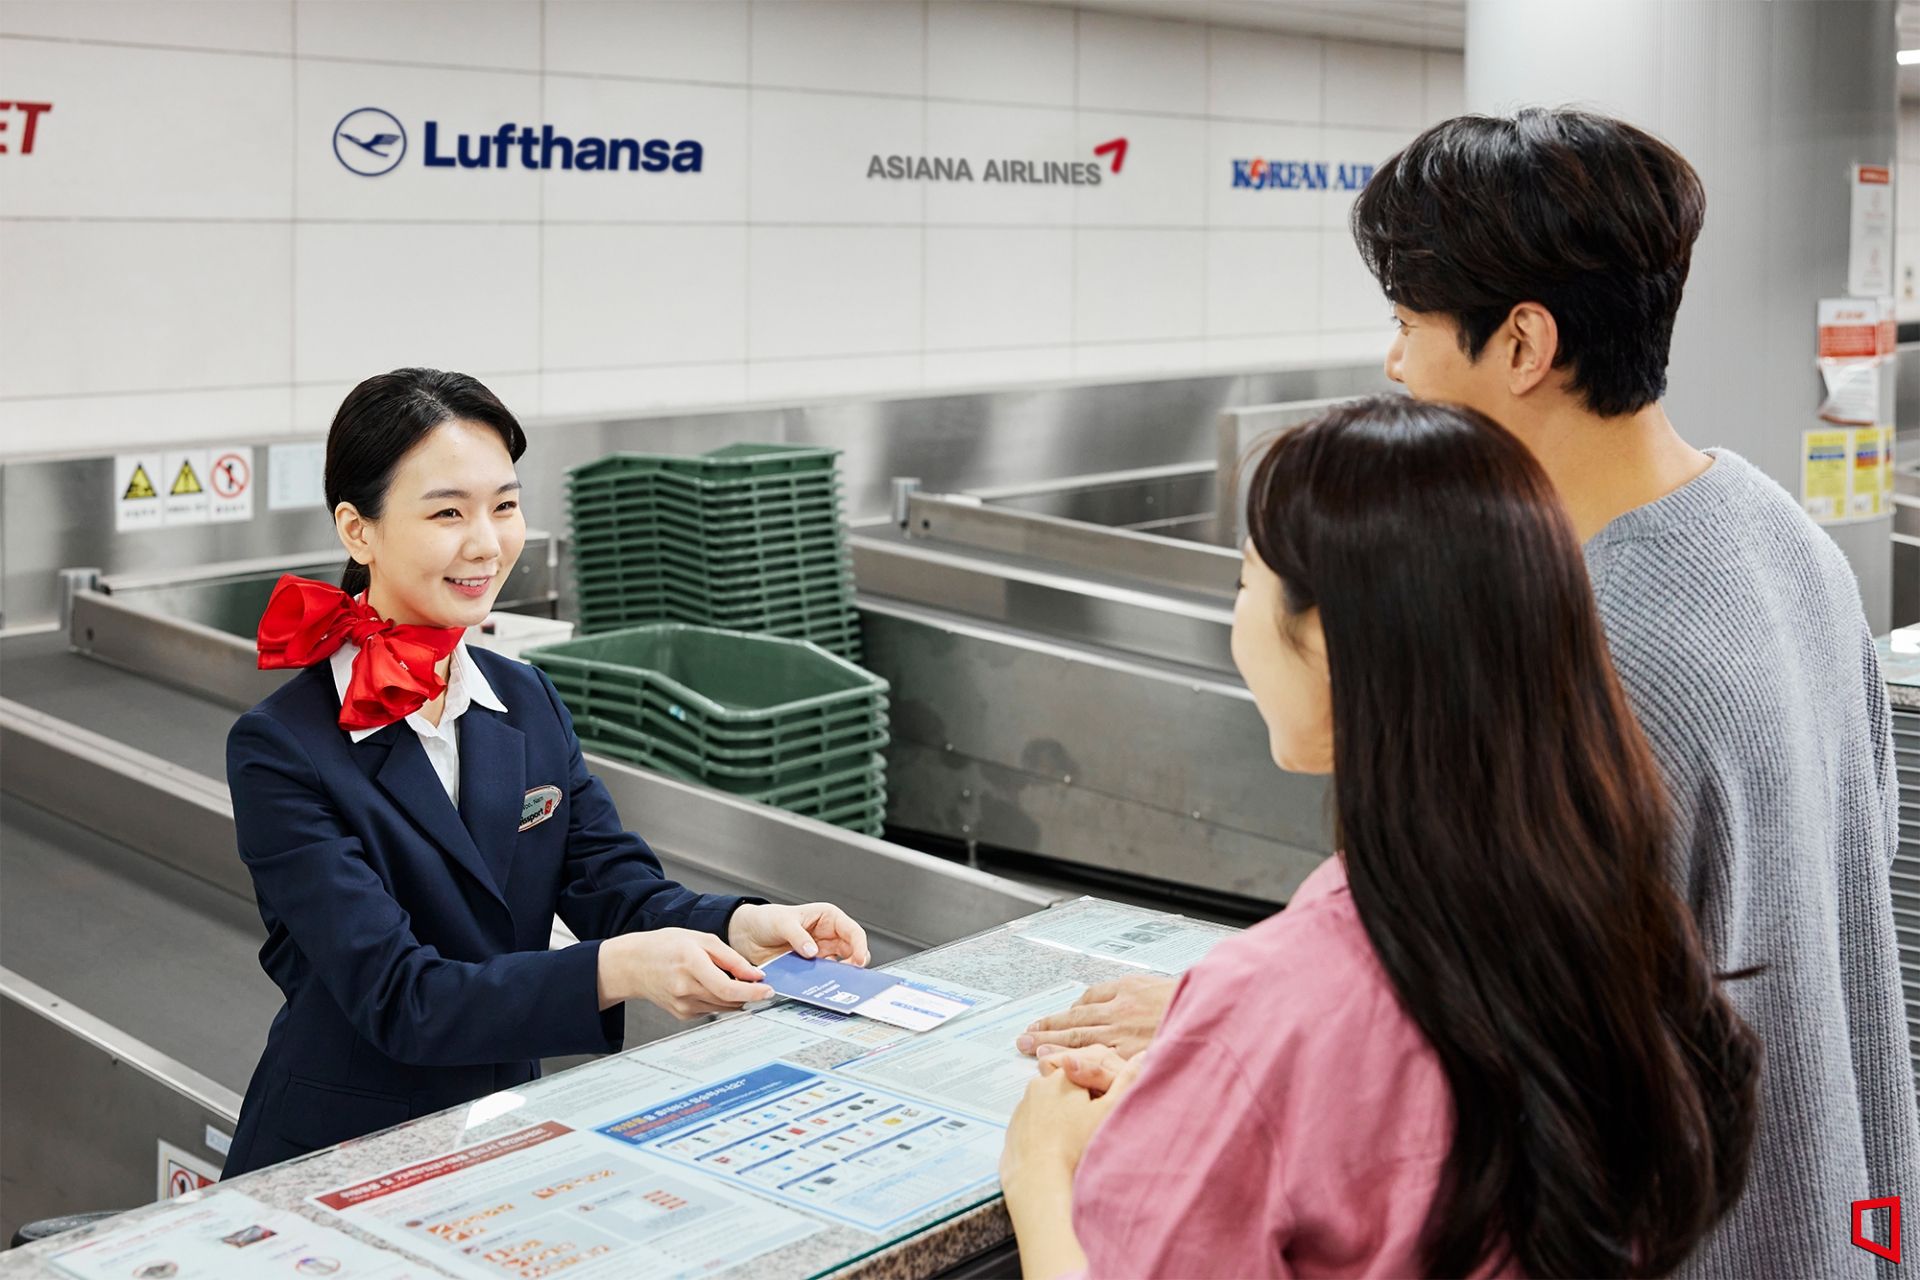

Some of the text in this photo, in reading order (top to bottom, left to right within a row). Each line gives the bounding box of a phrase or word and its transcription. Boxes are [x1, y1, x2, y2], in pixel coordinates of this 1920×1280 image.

[424, 121, 704, 173] Lufthansa
[866, 154, 1103, 186] ASIANA AIRLINES
[1232, 158, 1329, 190] KOREAN
